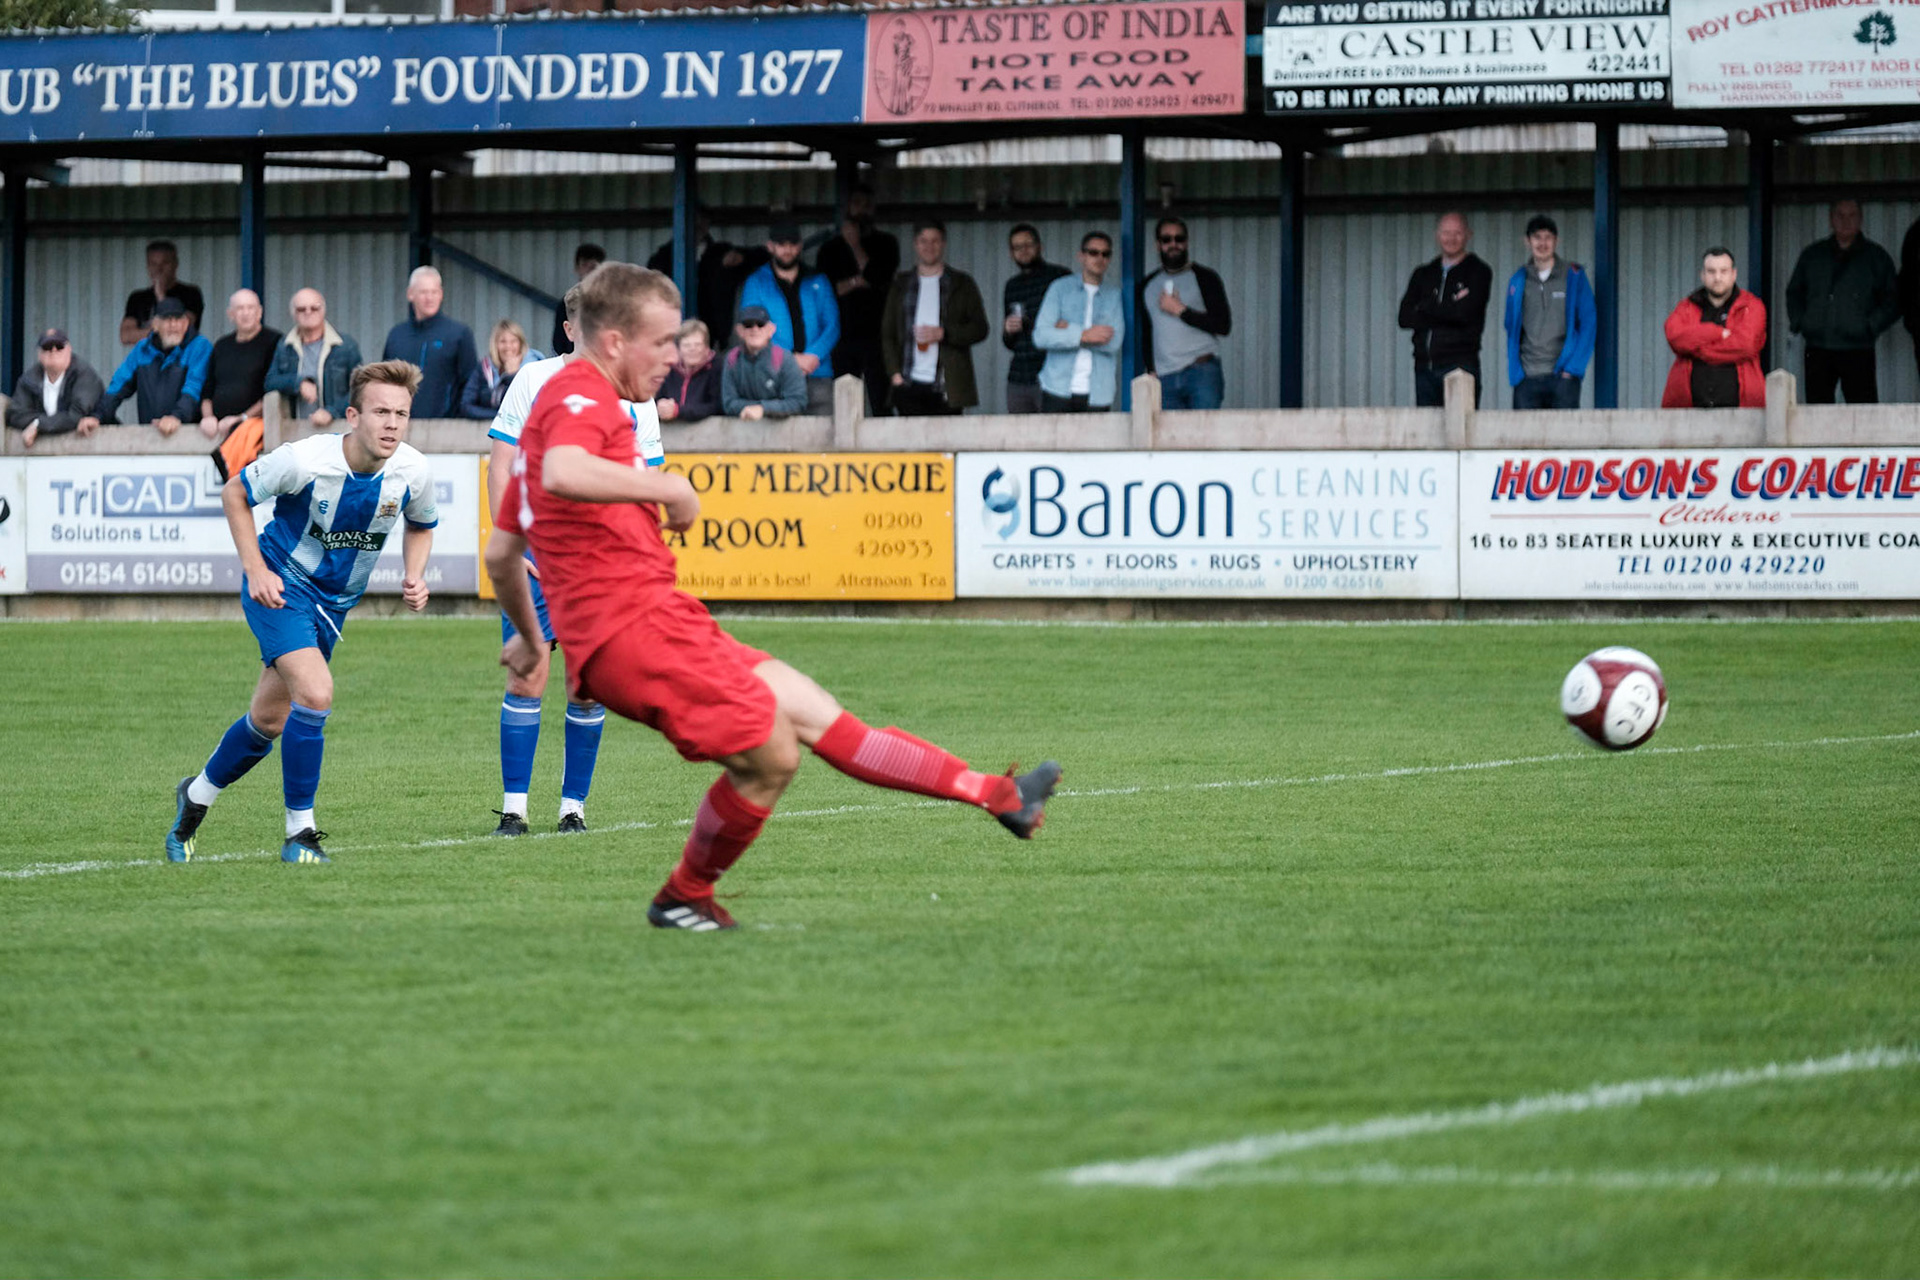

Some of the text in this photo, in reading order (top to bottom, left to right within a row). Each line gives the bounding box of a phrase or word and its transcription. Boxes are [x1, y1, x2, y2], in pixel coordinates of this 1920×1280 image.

[1277, 0, 1665, 24] ARE YOU GETTING IT EVERY FORTNIGHT?
[932, 7, 1234, 44] TASTE OF INDIA
[1687, 14, 1729, 41] ROY
[1340, 21, 1657, 59] CASTLE VIEW
[971, 49, 1190, 70] HOT FOOD
[1587, 55, 1662, 74] 422441
[1720, 63, 1749, 76] TEL
[1871, 59, 1910, 72] MOB
[0, 68, 61, 115] UB
[391, 52, 650, 105] FOUNDED
[661, 50, 725, 98] IN
[738, 48, 843, 97] 1877
[957, 71, 1204, 92] TAKE AWAY
[1335, 66, 1368, 79] FREE
[1371, 67, 1383, 78] to
[1274, 81, 1665, 108] TO BE IN IT OR FOR ANY PRINTING PHONE US
[1829, 79, 1864, 89] FREE
[751, 461, 947, 497] MERINGUE
[1251, 466, 1437, 497] CLEANING
[1491, 457, 1719, 500] HODSONS
[1029, 465, 1234, 538] Baron
[864, 511, 923, 530] 01200
[1258, 508, 1430, 539] SERVICES
[1659, 502, 1782, 526] Clitheroe
[51, 523, 186, 541] Solutions Ltd.
[314, 531, 373, 543] MONKS
[702, 517, 806, 552] ROOM
[1470, 532, 1920, 548] 16 to 83 SEATER LUXURY & EXECUTIVE COA
[993, 553, 1418, 570] CARPETS FLOORS RUGS UPHOLSTERY
[1618, 555, 1826, 574] TEL 01200 429220
[60, 562, 213, 585] 01254 614055
[729, 573, 743, 587] at
[836, 572, 947, 588] Afternoon Tea
[1284, 574, 1384, 589] 01200 426516
[1715, 580, 1859, 592] www.hodsonscoaches.com
